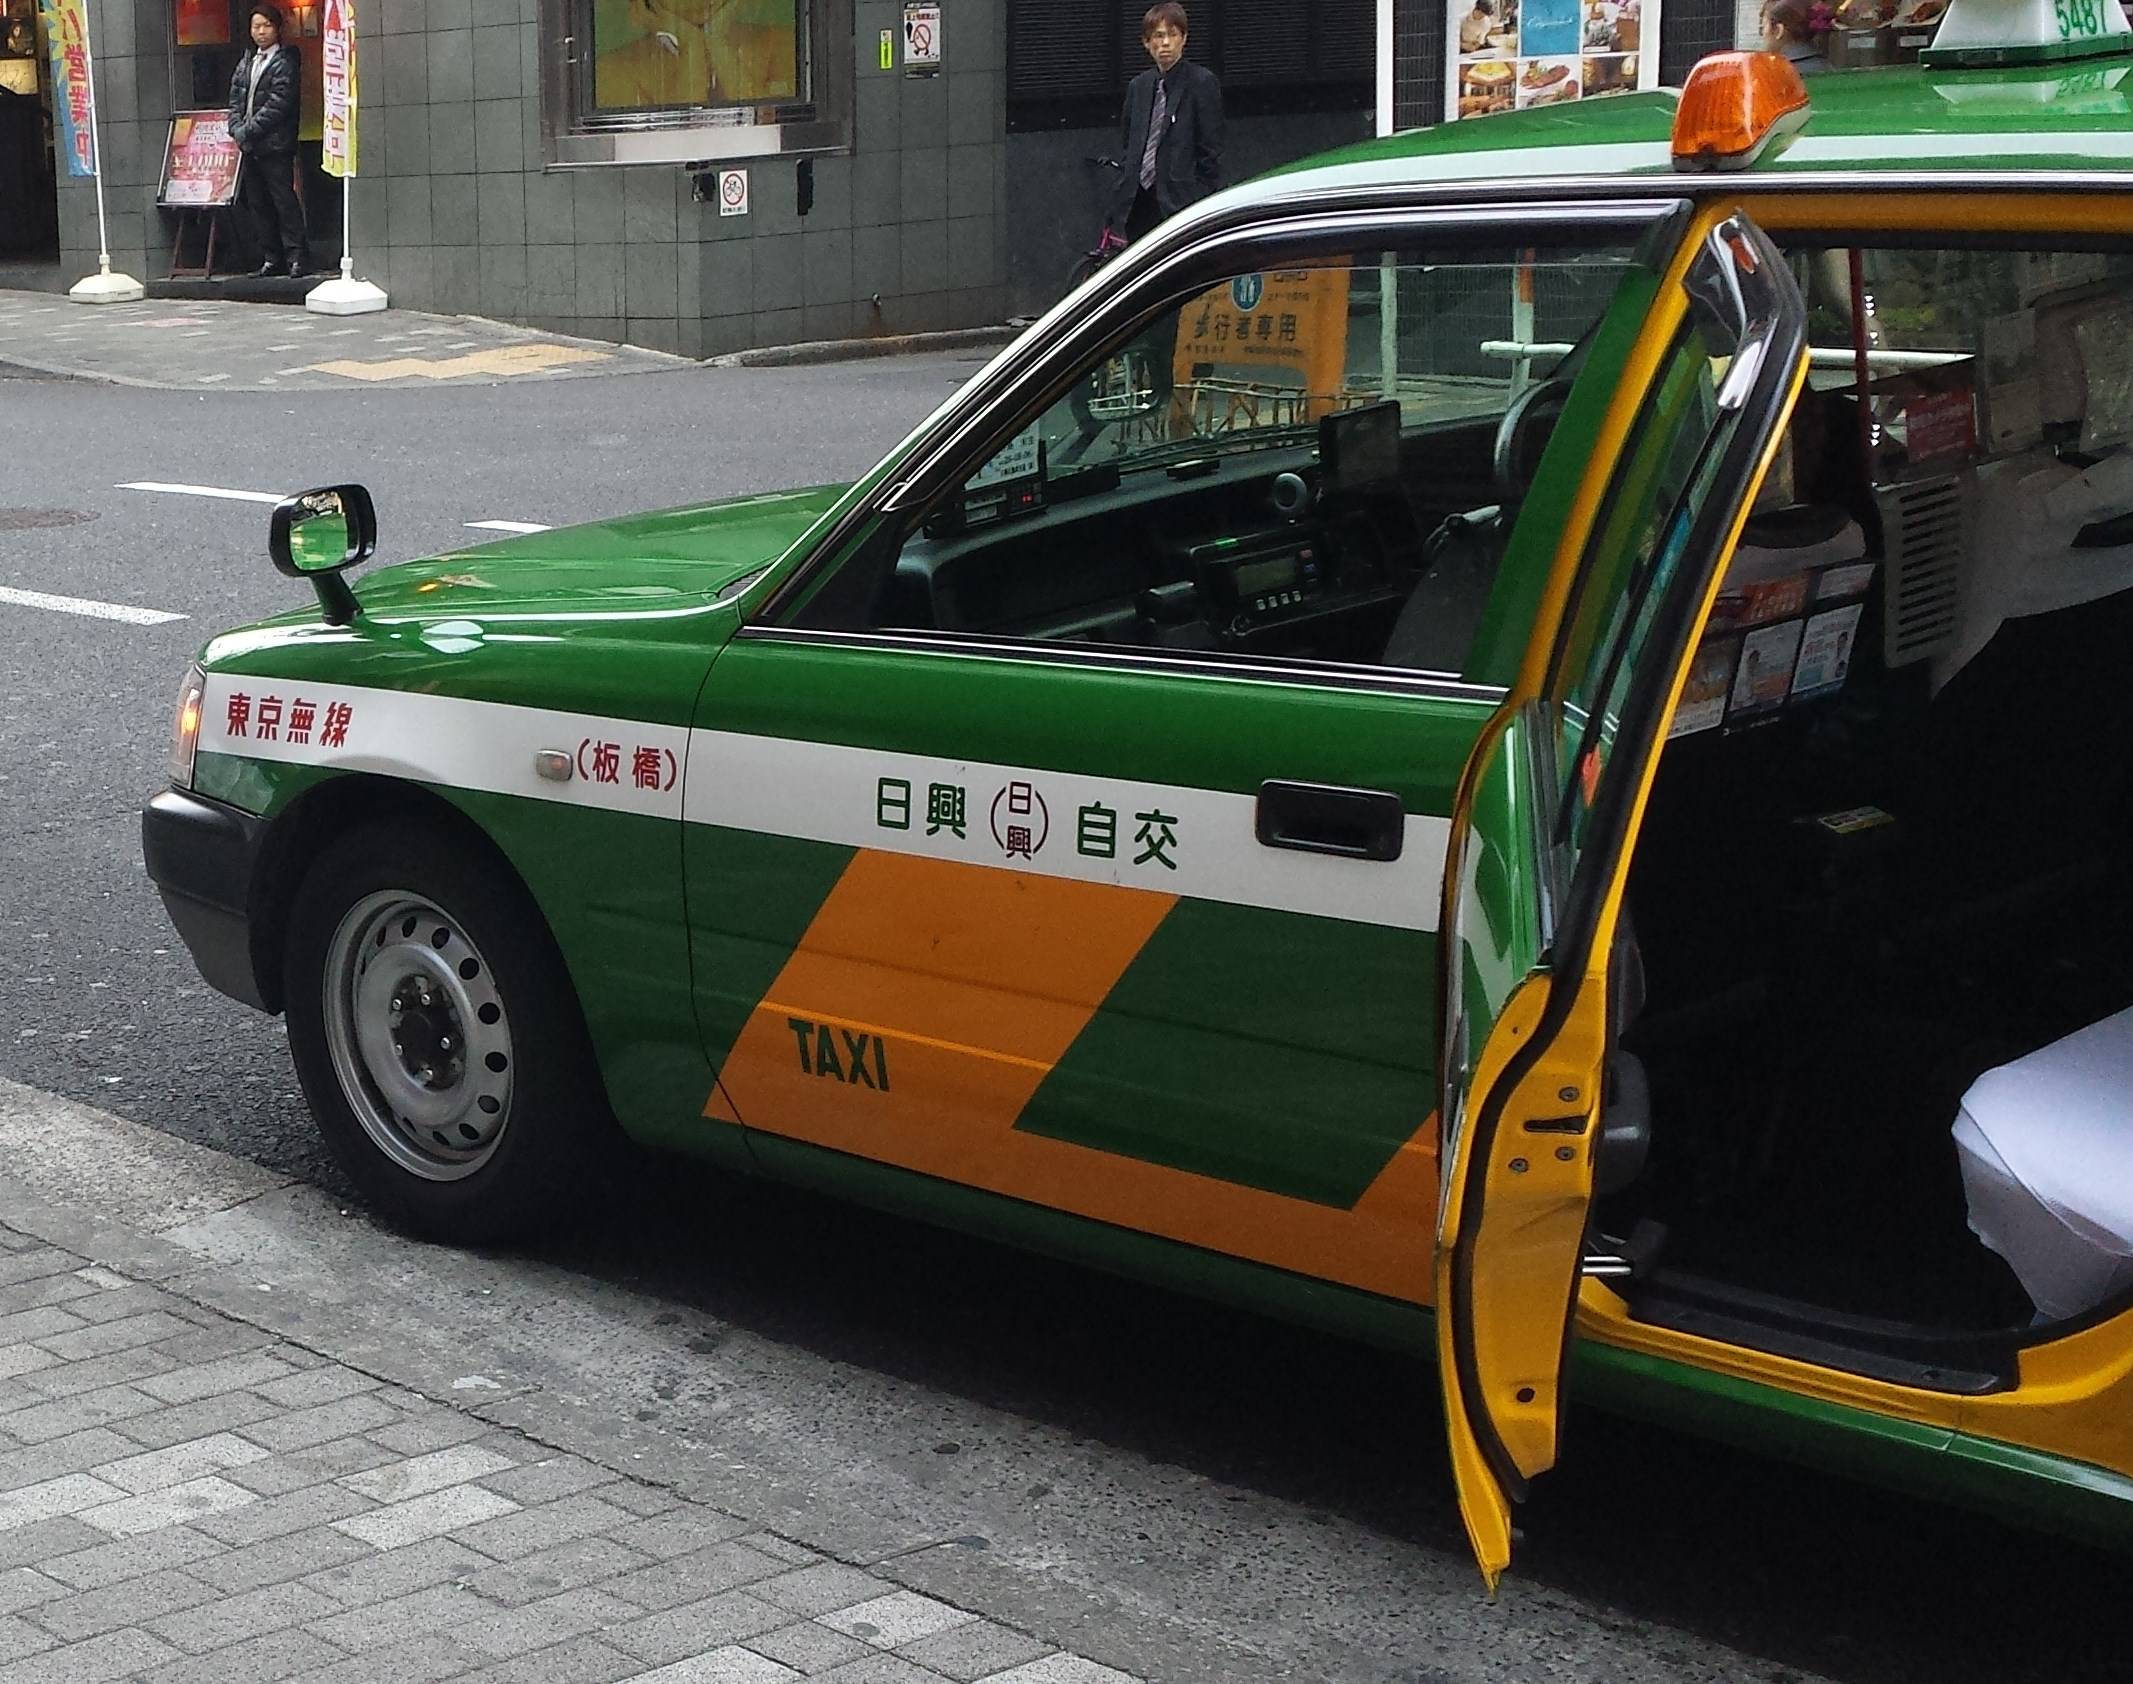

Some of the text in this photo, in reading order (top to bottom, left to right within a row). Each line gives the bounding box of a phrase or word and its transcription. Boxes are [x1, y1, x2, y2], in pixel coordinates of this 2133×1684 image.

[1194, 309, 1297, 342] 歩行者専用
[226, 693, 353, 748] 東京無線
[877, 777, 1178, 870] 日興 自交
[787, 1017, 890, 1092] TAXI
